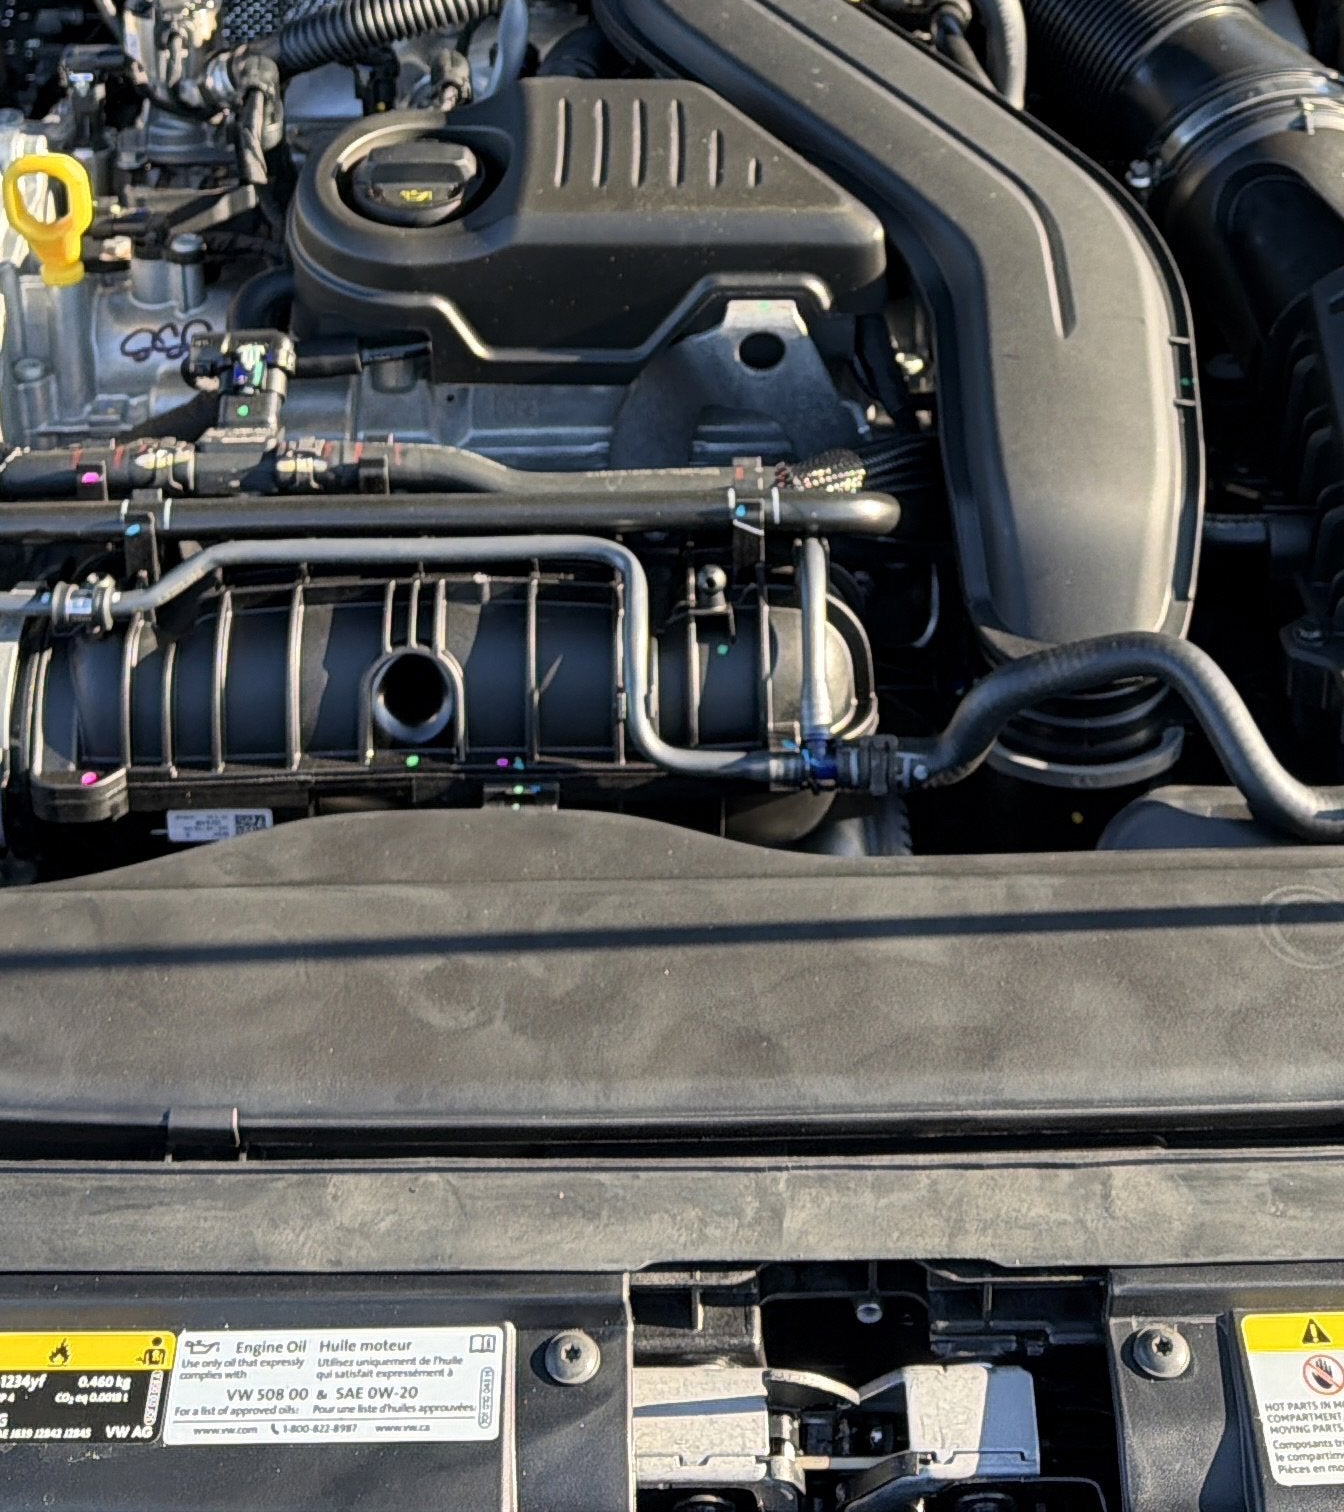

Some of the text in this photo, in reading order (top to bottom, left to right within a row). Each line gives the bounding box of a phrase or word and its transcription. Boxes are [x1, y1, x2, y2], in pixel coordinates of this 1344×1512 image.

[235, 1340, 307, 1357] Engine Oil
[319, 1339, 413, 1353] Huile moteur
[181, 1357, 305, 1370] Use only oil that expressly
[356, 1356, 417, 1369] uniquement
[418, 1356, 431, 1366] de
[433, 1355, 464, 1366] l'huile
[179, 1369, 247, 1382] complies with
[316, 1367, 454, 1381] qui satisfait expressément à
[77, 1374, 115, 1388] 0.460
[115, 1374, 132, 1391] kg
[7, 1392, 16, 1403] 4
[74, 1393, 89, 1406] eq
[226, 1386, 419, 1401] VW 508 00 & SAE 0W-20
[174, 1406, 191, 1416] For
[192, 1408, 199, 1416] a
[201, 1406, 216, 1416] list
[217, 1405, 229, 1415] of
[230, 1404, 277, 1418] approved
[312, 1404, 336, 1415] Pour
[337, 1405, 356, 1414] une
[357, 1403, 377, 1414] liste
[379, 1403, 417, 1414] d'huiles
[1264, 1402, 1285, 1412] HOT
[1287, 1400, 1319, 1411] PARTS
[1320, 1400, 1331, 1410] IN
[1266, 1411, 1342, 1424] COMPARTMENT
[105, 1424, 154, 1439] VW AG
[1269, 1424, 1311, 1435] MOVING
[1272, 1438, 1334, 1451] Composants
[1275, 1452, 1285, 1462] le
[1277, 1463, 1311, 1475] Pièces
[1312, 1464, 1326, 1473] en
